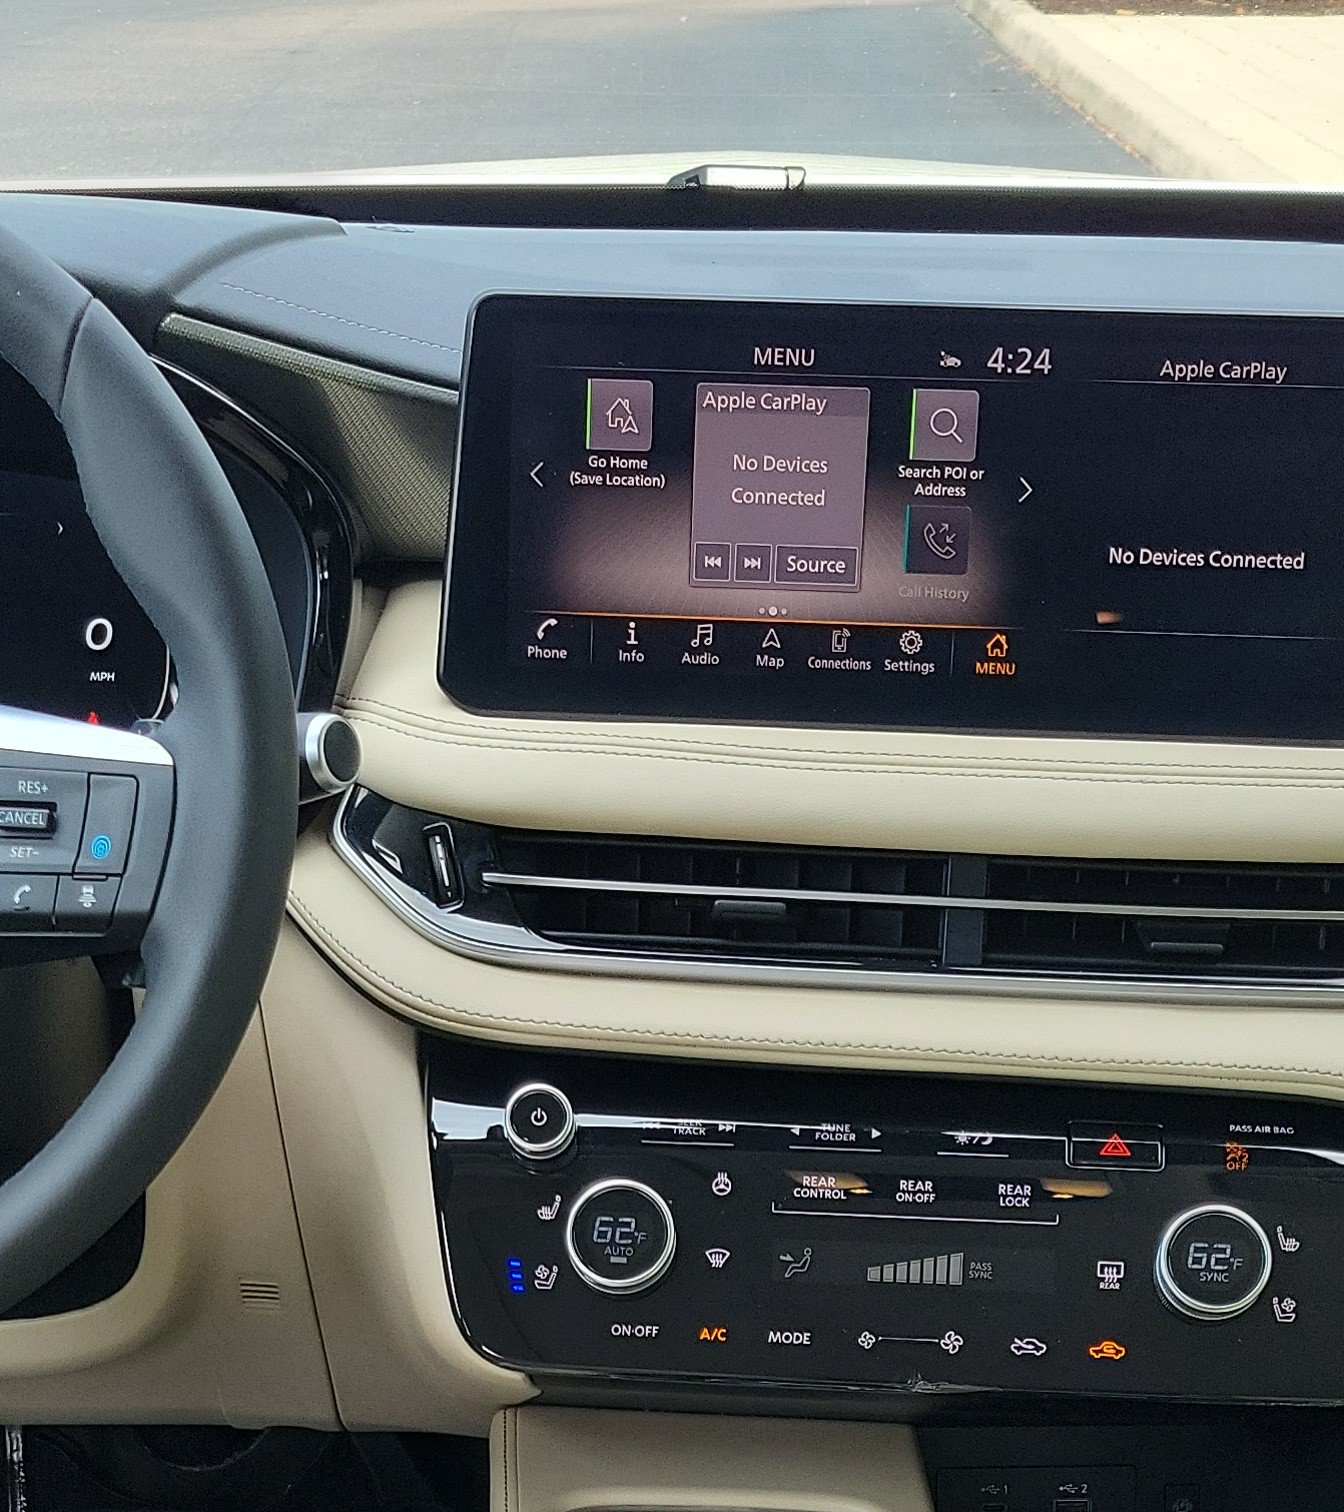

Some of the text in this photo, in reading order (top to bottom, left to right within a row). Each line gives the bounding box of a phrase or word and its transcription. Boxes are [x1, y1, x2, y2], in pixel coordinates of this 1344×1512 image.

[754, 347, 815, 367] MENU
[986, 347, 1052, 375] 4:24
[1160, 360, 1288, 384] Apple CarPlay
[702, 391, 826, 415] Apple CarPlay
[588, 457, 648, 470] Go Home
[733, 455, 828, 474] No Devices
[898, 465, 985, 481] Search POI or
[569, 472, 666, 489] (Save Location)
[914, 482, 966, 498] Address
[731, 488, 825, 507] Connected
[1109, 547, 1306, 569] No Devices Connected
[786, 556, 846, 575] Source
[898, 585, 970, 602] Call History
[527, 644, 568, 661] Phone
[618, 648, 645, 663] Info
[681, 650, 720, 667] Audio
[756, 655, 785, 670] Map
[808, 656, 872, 671] Connections
[884, 659, 935, 675] Settings
[975, 661, 1016, 676] MENU
[90, 672, 115, 682] MPH
[18, 781, 50, 794] RES+
[673, 1126, 706, 1136] TRACK
[821, 1123, 851, 1133] TUNE
[1229, 1124, 1295, 1135] PASS AIR BAG
[815, 1131, 856, 1142] FOLDER
[1226, 1161, 1248, 1171] OFF
[802, 1176, 836, 1188] REAR
[899, 1180, 933, 1192] REAR
[793, 1187, 847, 1200] CONTROL
[998, 1184, 1031, 1196] REAR
[999, 1196, 1030, 1207] LOCK
[604, 1246, 634, 1257] AUTO
[970, 1261, 993, 1271] PASS
[968, 1270, 993, 1280] SYNC
[1199, 1272, 1229, 1283] SYNC
[1099, 1282, 1120, 1290] REAR
[699, 1328, 727, 1342] A/C
[768, 1331, 811, 1345] MODE
[1003, 1485, 1010, 1496] 1
[1081, 1484, 1088, 1495] 2
